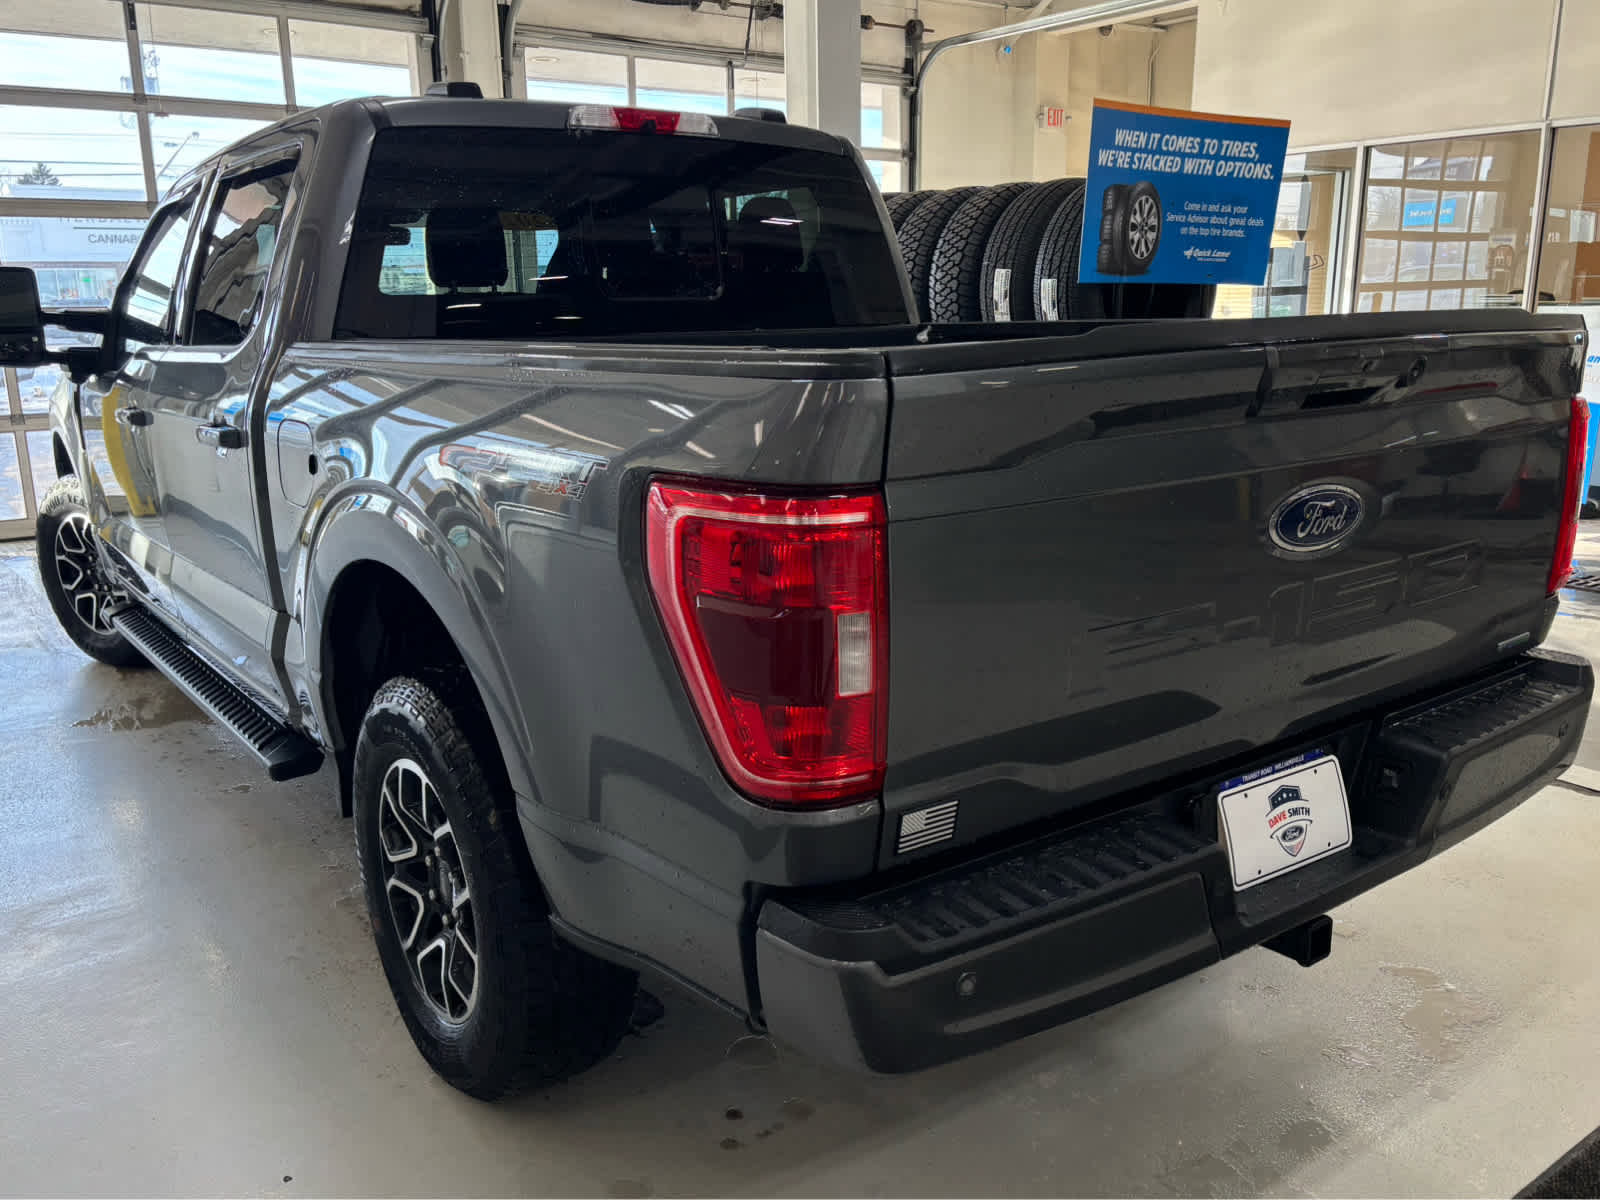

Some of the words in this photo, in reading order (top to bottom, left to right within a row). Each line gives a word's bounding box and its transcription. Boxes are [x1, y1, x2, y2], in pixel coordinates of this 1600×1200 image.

[1047, 107, 1065, 128] EXIT
[1114, 127, 1148, 149] WHEN
[1148, 132, 1161, 151] IT
[1161, 133, 1201, 154] COMES
[1202, 137, 1219, 156] TO
[1220, 139, 1260, 162] TIRES,
[1098, 147, 1132, 168] WE'RE
[1132, 151, 1182, 174] STACKED
[1183, 157, 1216, 176] WITH
[1215, 160, 1275, 180] OPTIONS.
[1184, 200, 1201, 212] Come
[1201, 202, 1208, 212] in
[1208, 202, 1220, 213] and
[1220, 204, 1232, 214] ask
[1232, 205, 1249, 216] your
[1166, 212, 1187, 222] Service
[1209, 215, 1228, 225] about
[1228, 217, 1247, 228] great
[1247, 216, 1265, 227] deals
[1188, 225, 1199, 236] the
[1297, 499, 1347, 538] Ford
[1268, 810, 1287, 829] DAVE
[1287, 806, 1311, 818] SMITH
